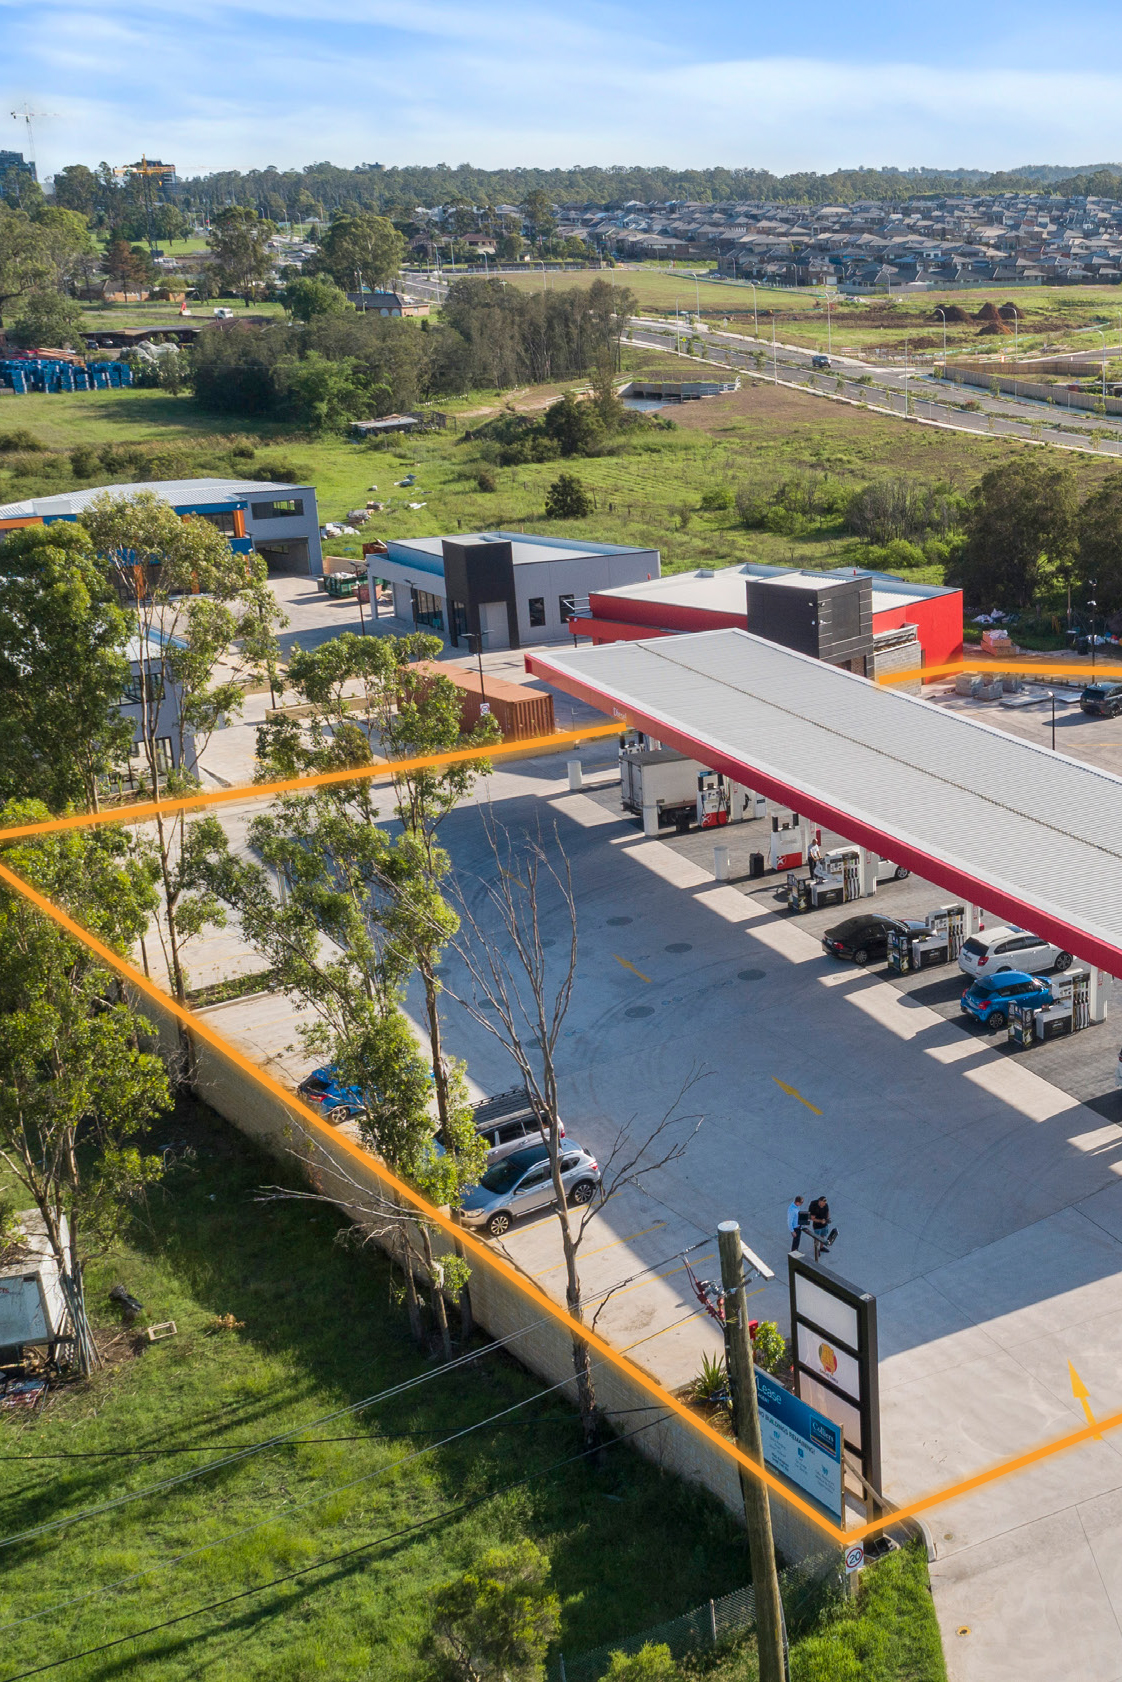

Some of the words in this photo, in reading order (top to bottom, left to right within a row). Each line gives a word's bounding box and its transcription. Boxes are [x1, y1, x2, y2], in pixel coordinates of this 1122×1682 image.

[757, 1377, 782, 1405] Lease
[812, 1421, 834, 1443] Colliers
[849, 1550, 861, 1565] 20
